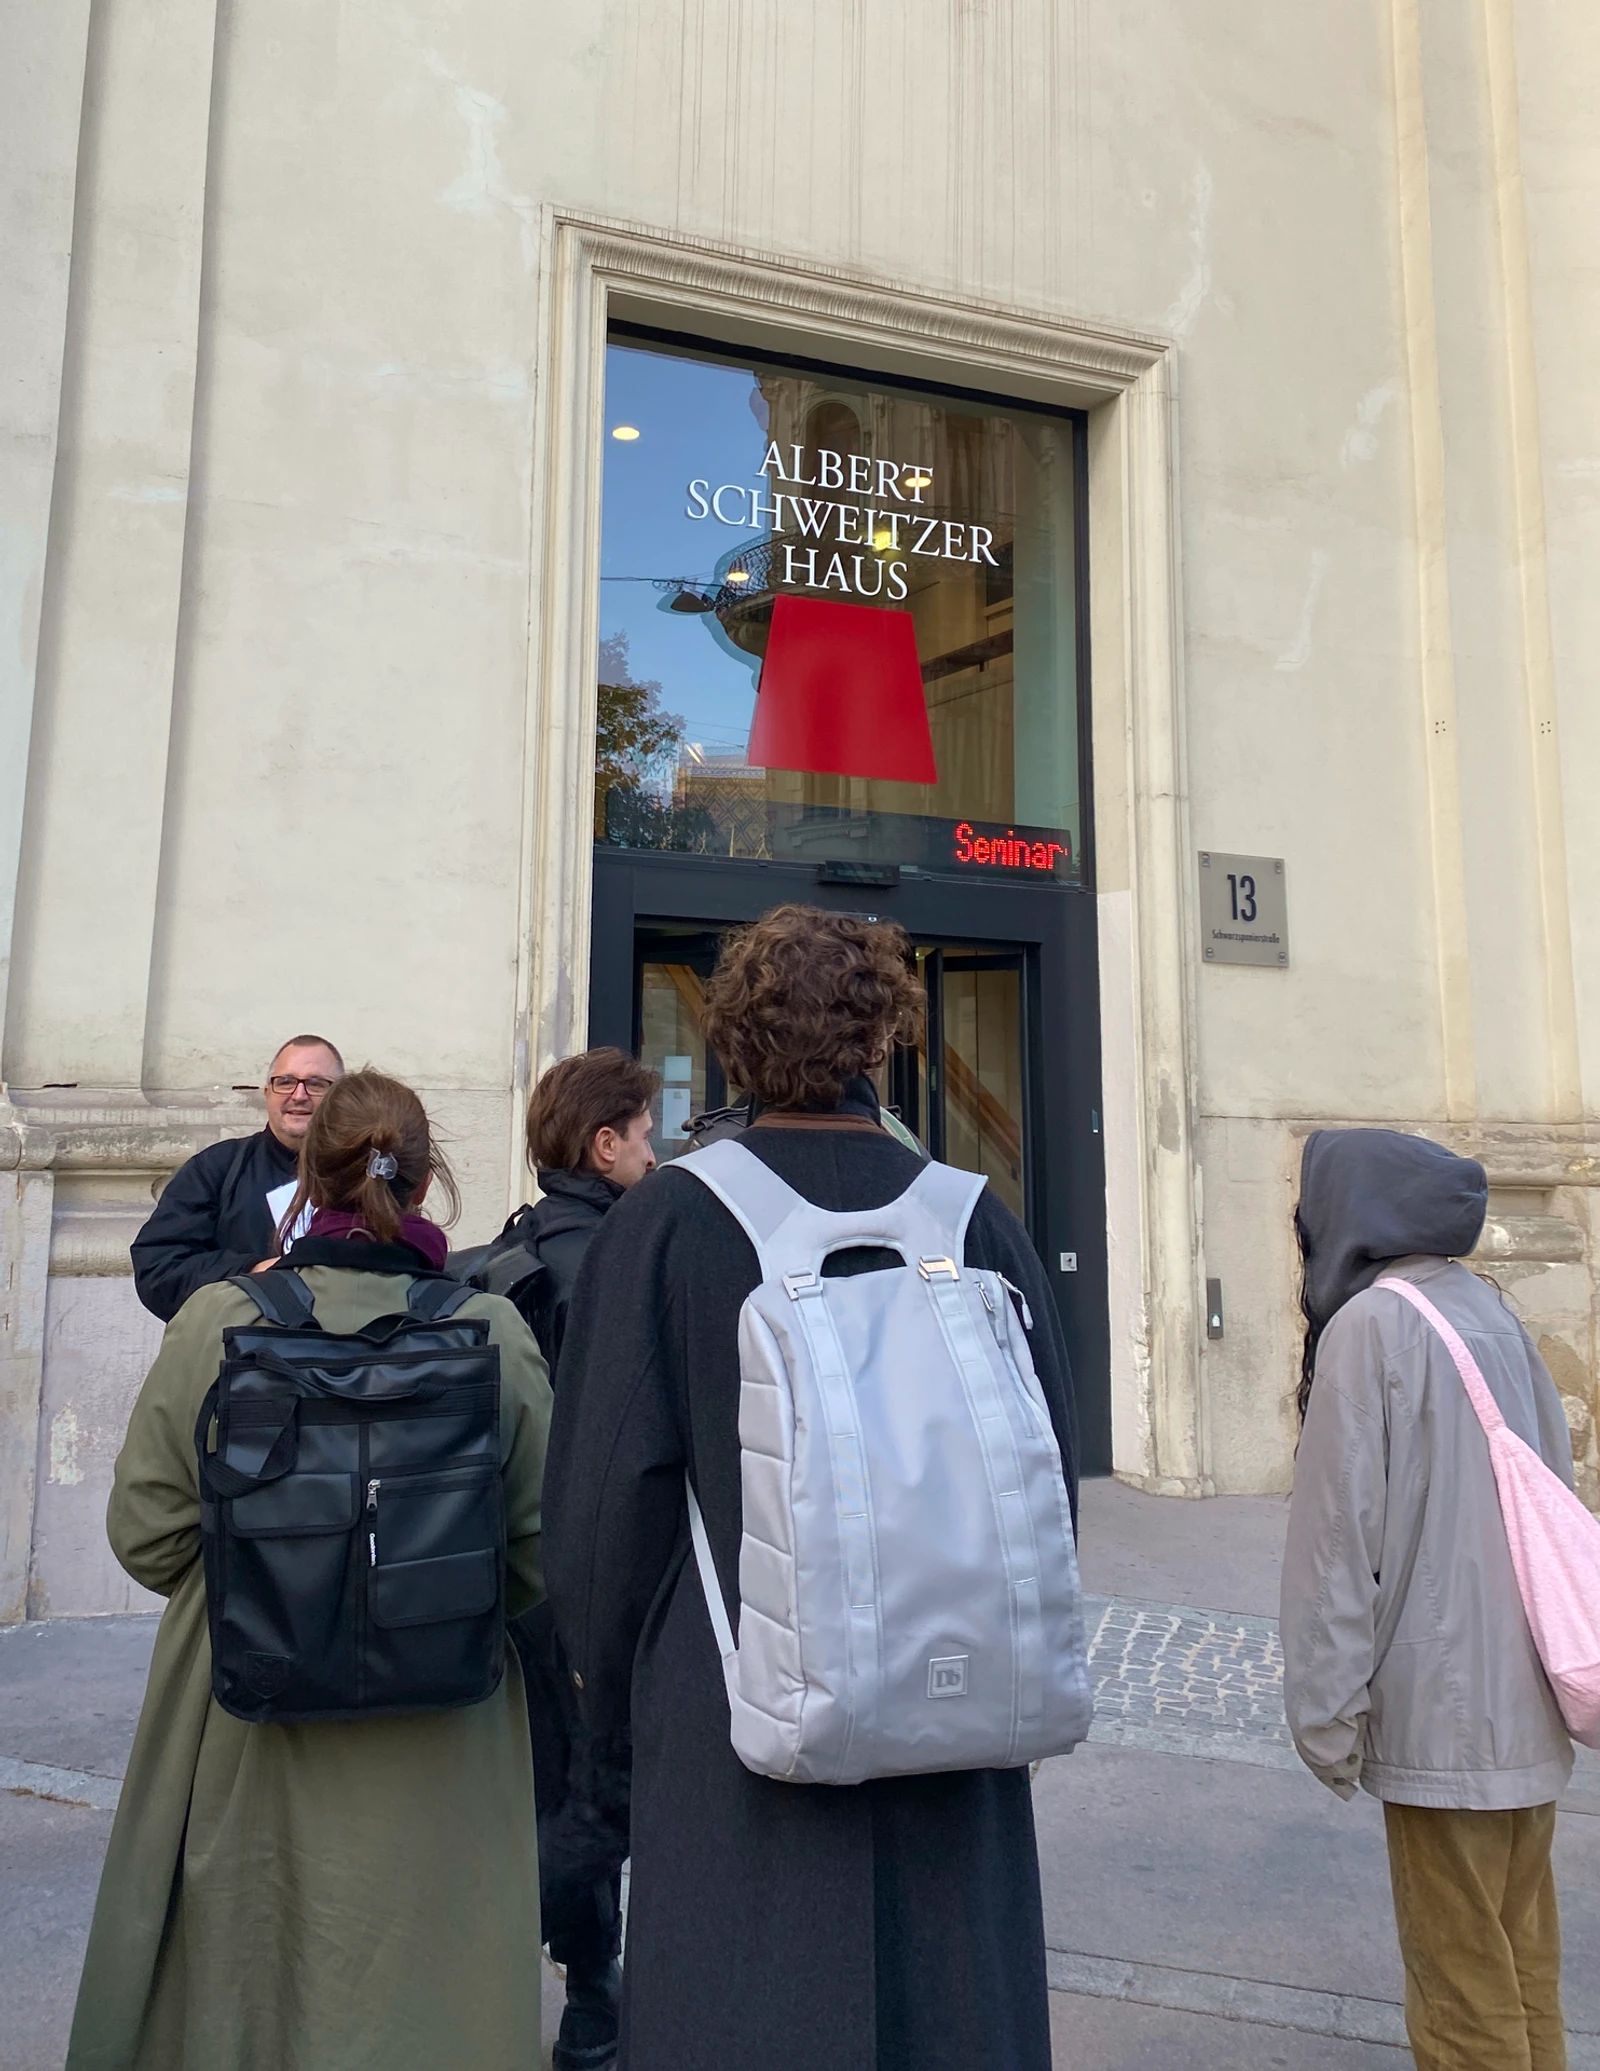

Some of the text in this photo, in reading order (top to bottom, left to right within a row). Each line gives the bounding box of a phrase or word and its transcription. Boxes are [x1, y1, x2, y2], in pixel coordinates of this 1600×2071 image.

[756, 440, 934, 503] ALBERT
[686, 479, 1000, 567] SCHWEITZER
[782, 544, 908, 600] HAUS
[954, 822, 1068, 870] Seminar
[1226, 874, 1257, 922] 13
